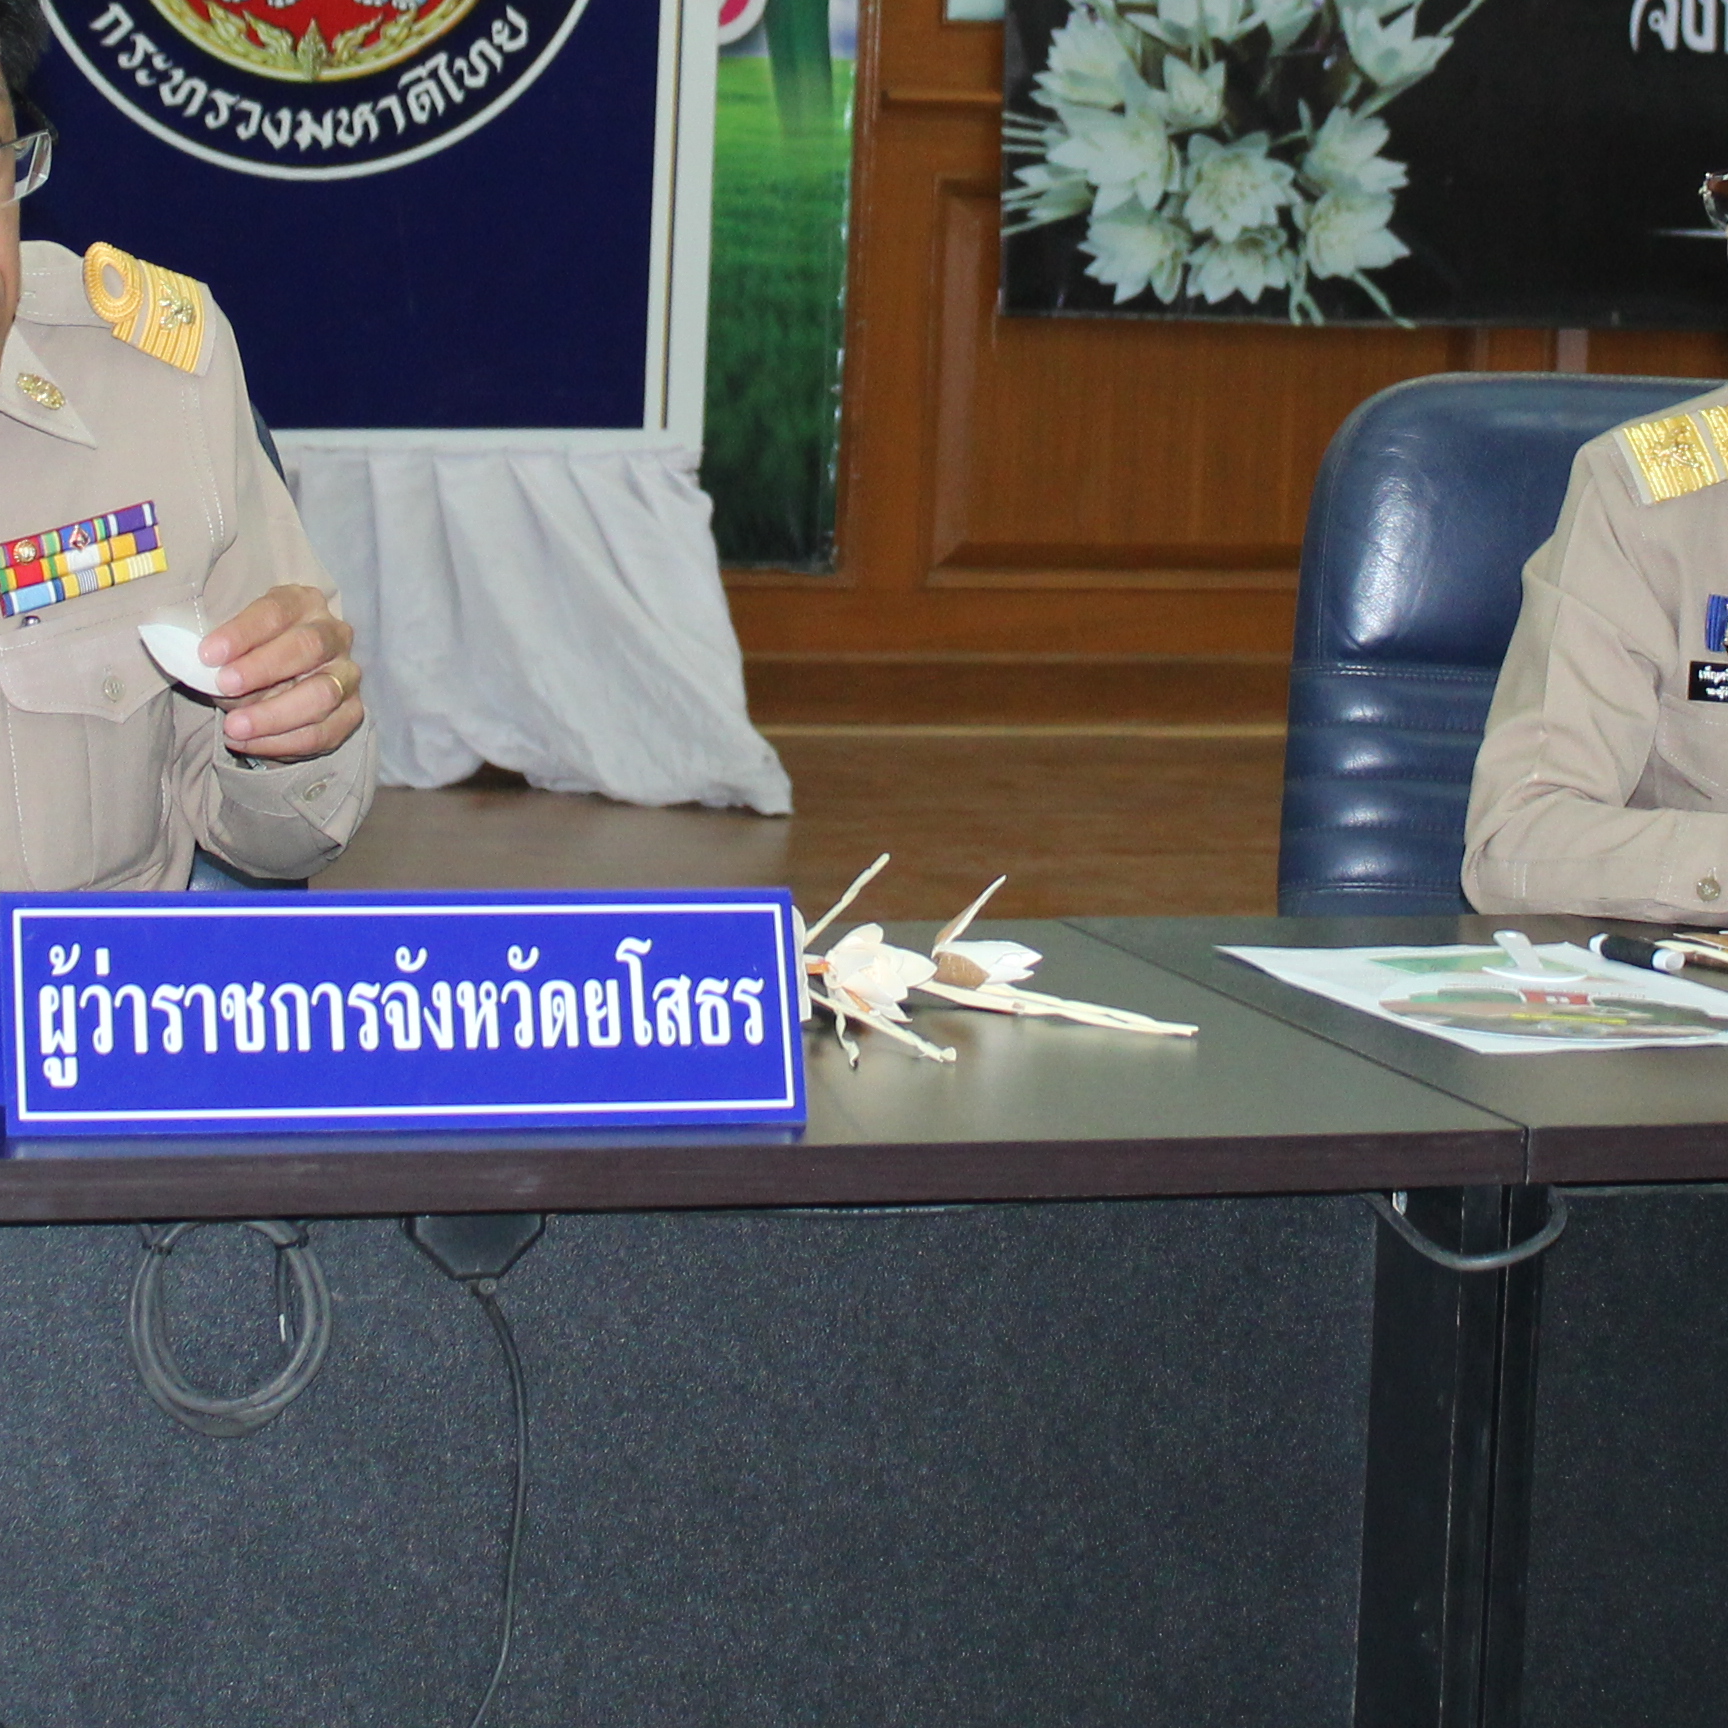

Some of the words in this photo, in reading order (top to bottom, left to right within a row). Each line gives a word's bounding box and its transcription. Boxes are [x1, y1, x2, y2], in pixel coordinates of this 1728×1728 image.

[89, 2, 528, 151] กระทรวงมหาดไทย
[38, 938, 764, 1086] ผู้ว่าราชการจังหวัดยโสธร
